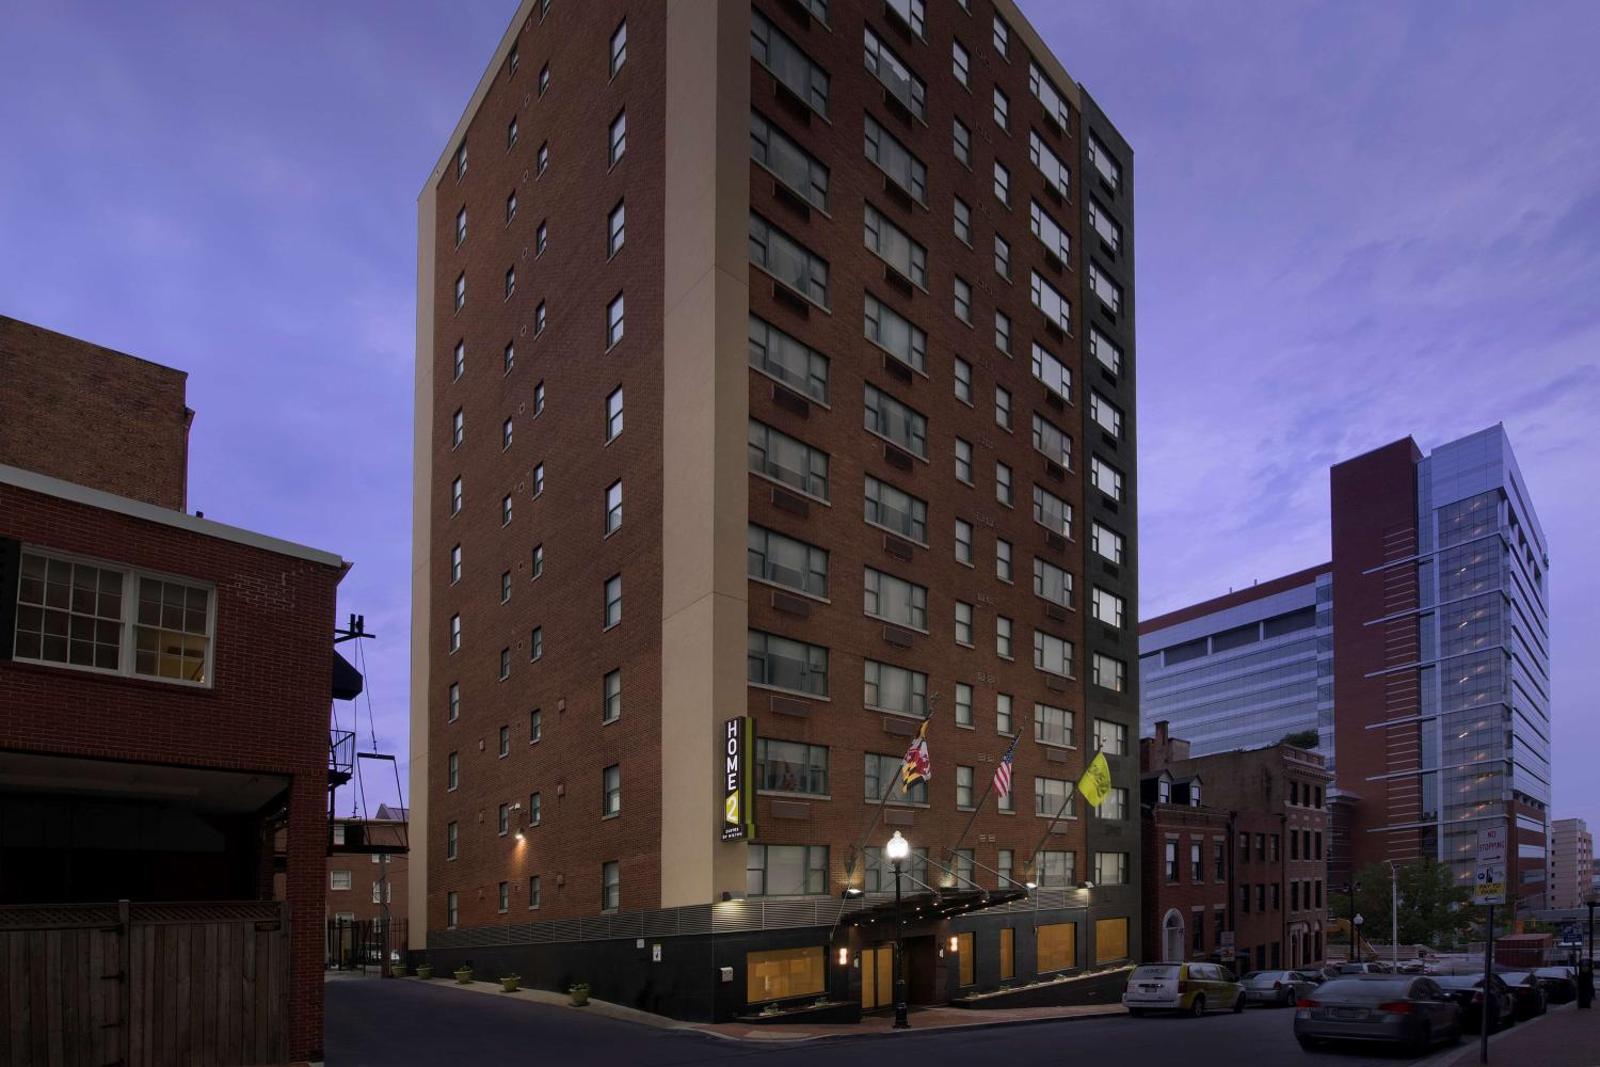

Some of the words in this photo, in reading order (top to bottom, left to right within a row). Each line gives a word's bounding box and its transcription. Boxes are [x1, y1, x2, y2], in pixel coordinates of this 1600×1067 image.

[726, 720, 738, 791] HOME
[1487, 830, 1497, 838] NO
[1479, 840, 1505, 852] STOPPING
